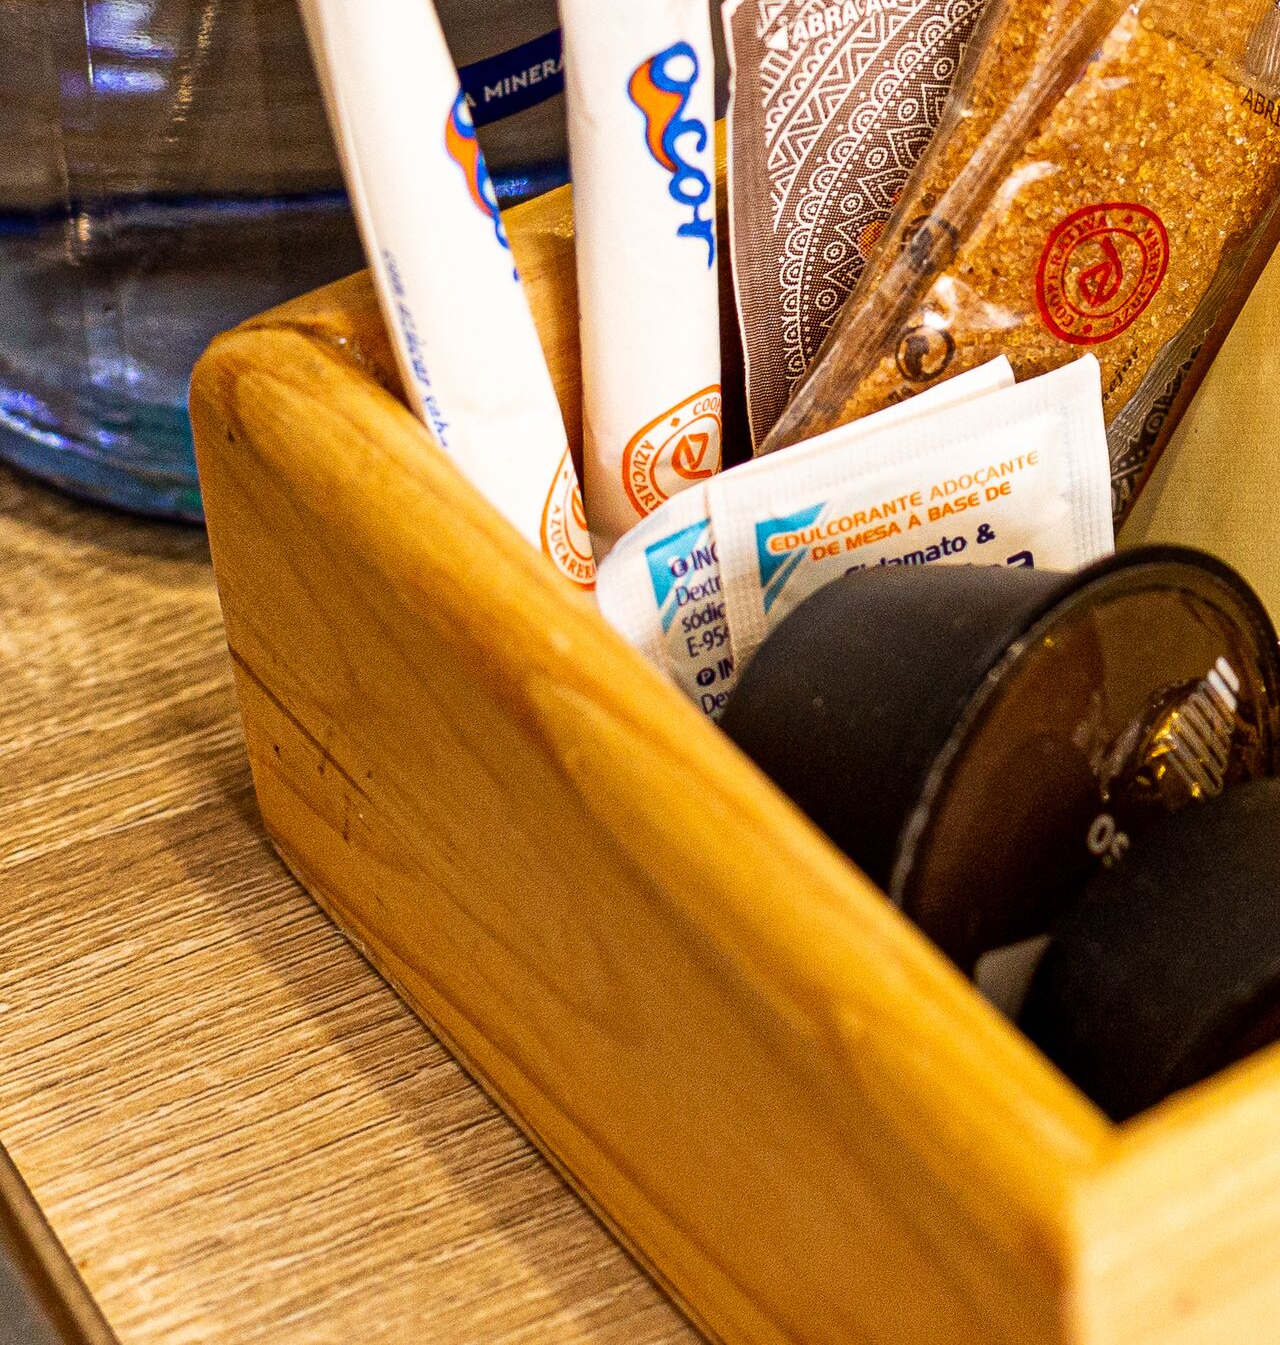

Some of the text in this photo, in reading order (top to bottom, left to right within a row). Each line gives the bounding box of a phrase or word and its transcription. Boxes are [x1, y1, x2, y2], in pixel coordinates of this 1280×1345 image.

[483, 57, 563, 104] MINER
[769, 450, 1040, 553] EDULCORANTE ADOÇANTE
[810, 543, 840, 563] DE
[845, 521, 902, 554] MESA
[927, 494, 981, 524] BASE
[985, 481, 1013, 503] DE
